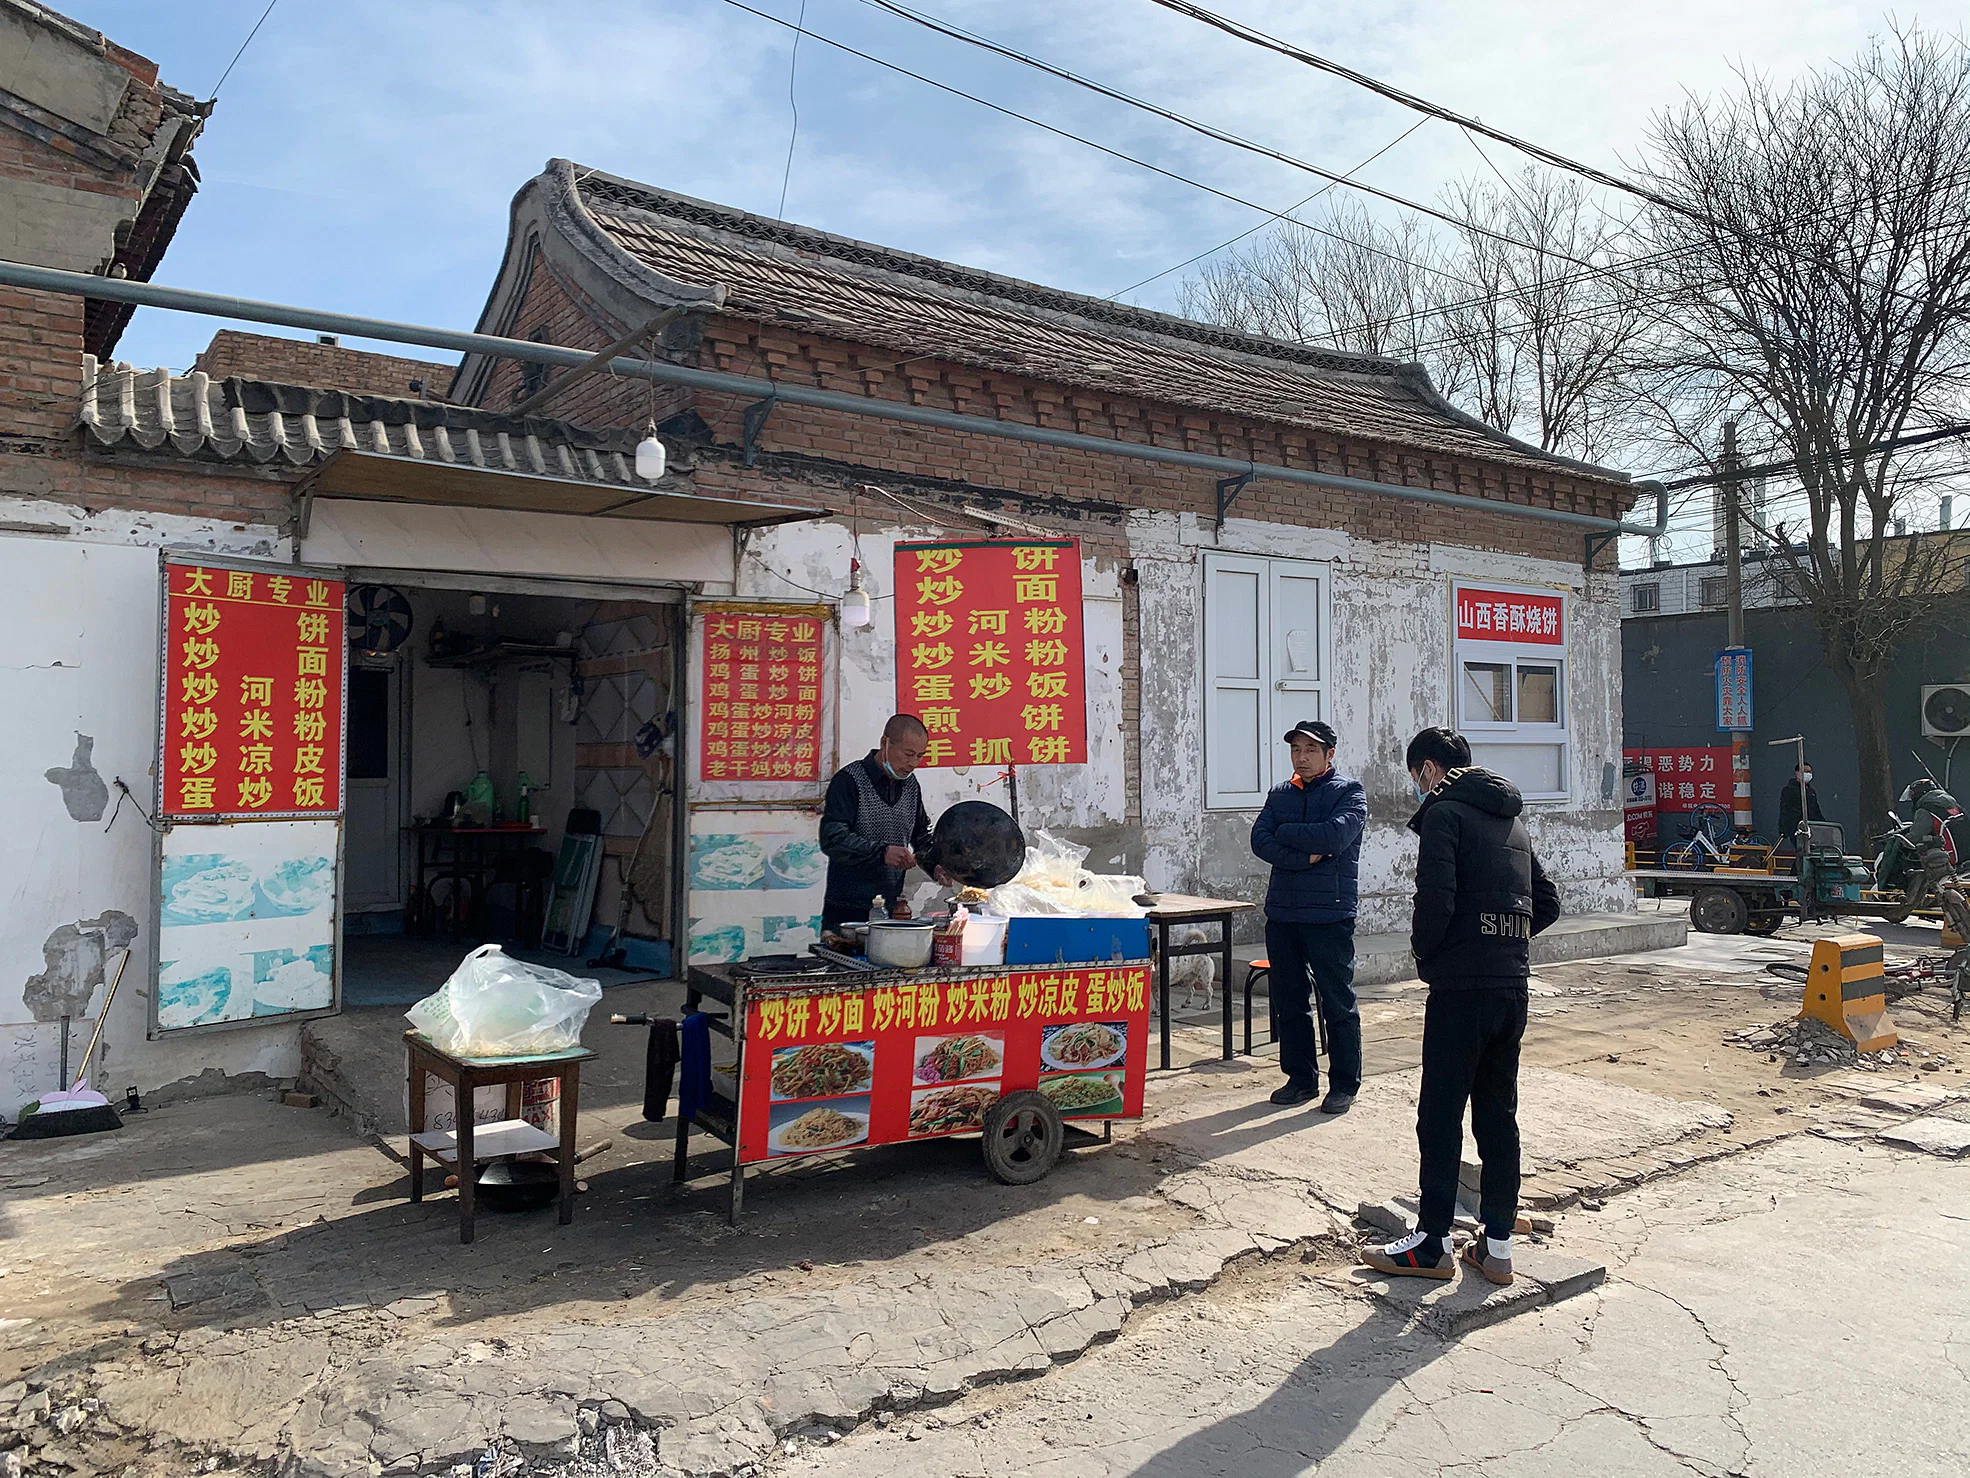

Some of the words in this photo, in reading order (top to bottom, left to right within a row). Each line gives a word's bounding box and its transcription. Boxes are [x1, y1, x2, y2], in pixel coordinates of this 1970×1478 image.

[184, 567, 330, 608] 大厨专业
[709, 619, 816, 643] 大厨专业
[910, 606, 1068, 637] 炒河粉
[1459, 599, 1558, 636] 山西香酥烧饼
[709, 643, 817, 664] 扬州炒饭
[911, 638, 1069, 670] 炒米粉
[709, 663, 818, 683] 鸡蛋炒饼
[911, 671, 1070, 702] 蛋炒饭
[181, 671, 328, 709] 炒河粉
[708, 682, 817, 702] 鸡蛋炒面
[179, 707, 327, 742] 炒米粉
[707, 702, 815, 721] 鸡蛋炒河粉
[707, 721, 815, 741] 鸡蛋炒凉皮
[179, 742, 326, 775] 炒凉皮
[706, 740, 815, 760] 鸡蛋炒米粉
[924, 735, 1071, 767] 手抓饼
[706, 760, 813, 778] 老干妈炒饭
[179, 776, 325, 809] 蛋炒饭
[1658, 781, 1716, 800] 谐稳定
[758, 998, 811, 1041] 炒饼
[816, 990, 865, 1037] 炒面
[871, 983, 940, 1032] 炒河粉
[945, 976, 1012, 1026] 炒米粉
[1016, 972, 1080, 1020] 炒凉皮
[1086, 969, 1145, 1016] 蛋炒饭
